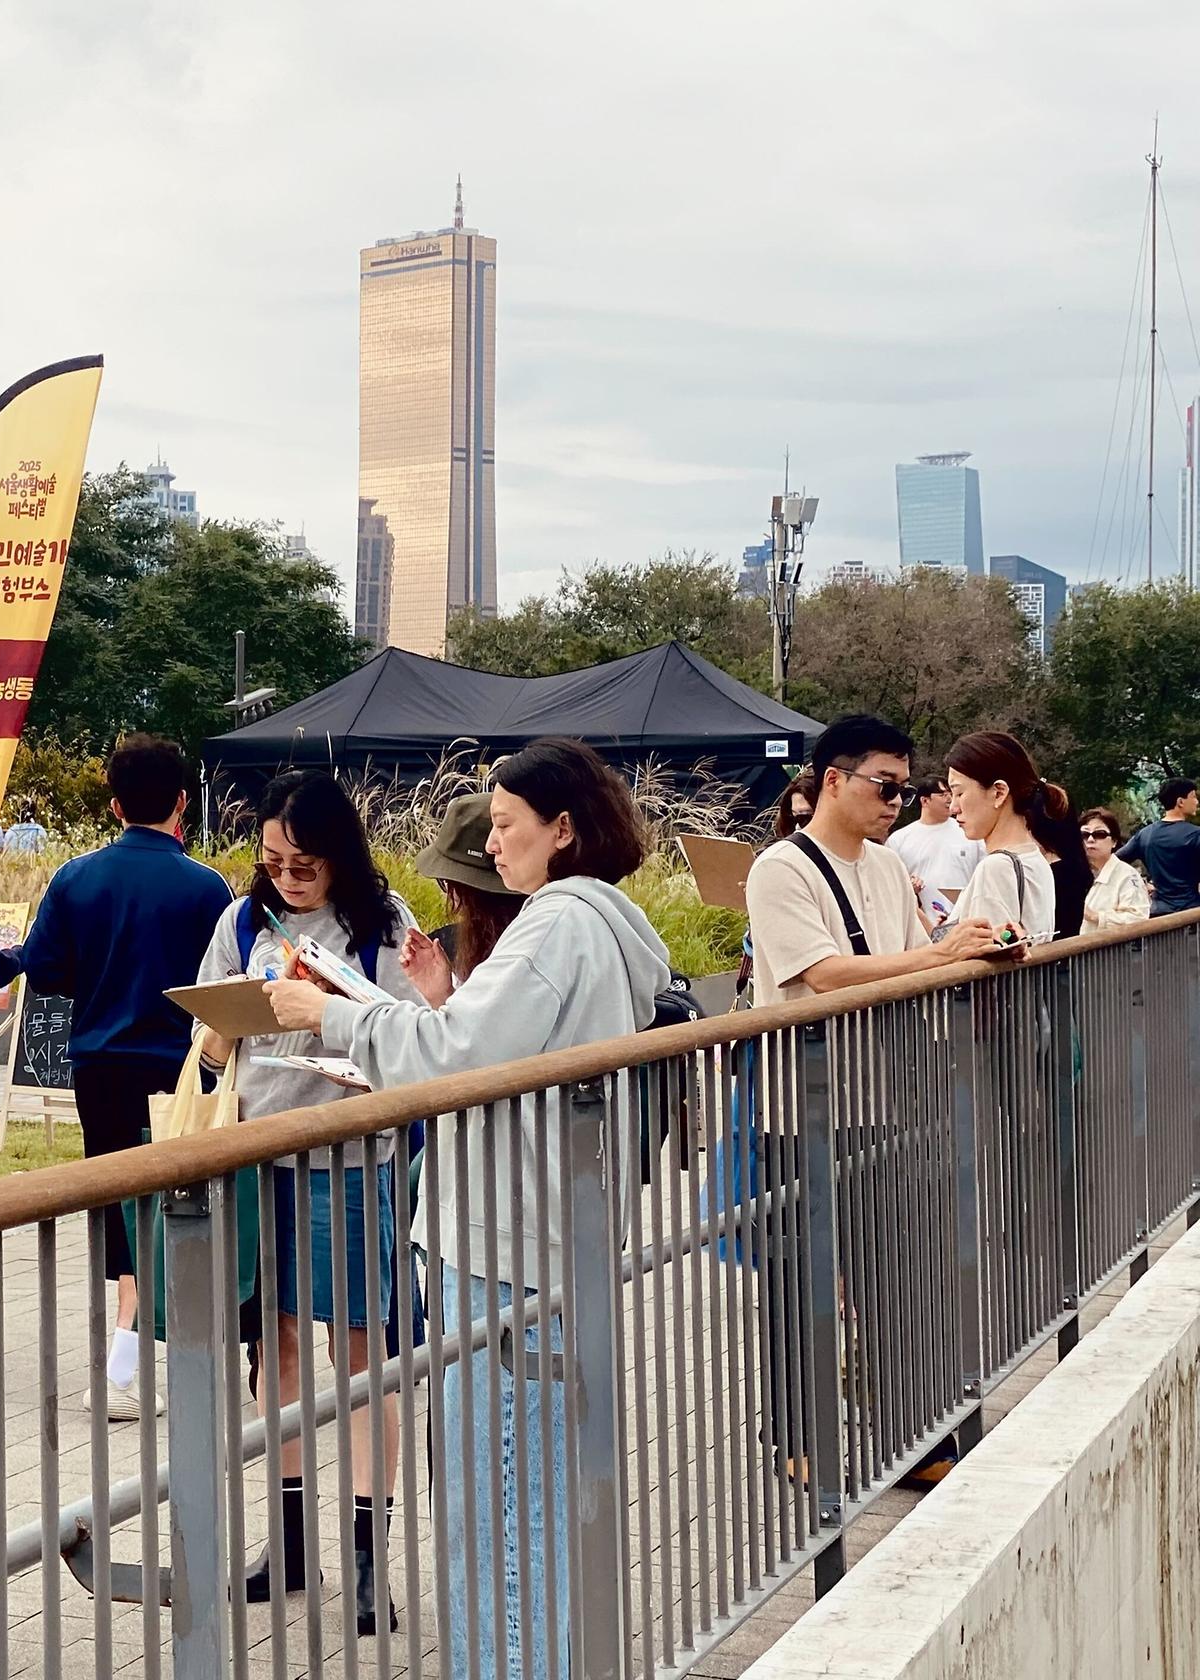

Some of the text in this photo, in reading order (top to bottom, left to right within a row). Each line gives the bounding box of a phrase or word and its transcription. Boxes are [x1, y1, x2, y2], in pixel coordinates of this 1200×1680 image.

[400, 242, 440, 256] Hanwha
[18, 460, 41, 472] 2025
[8, 498, 47, 520] 페스티벌
